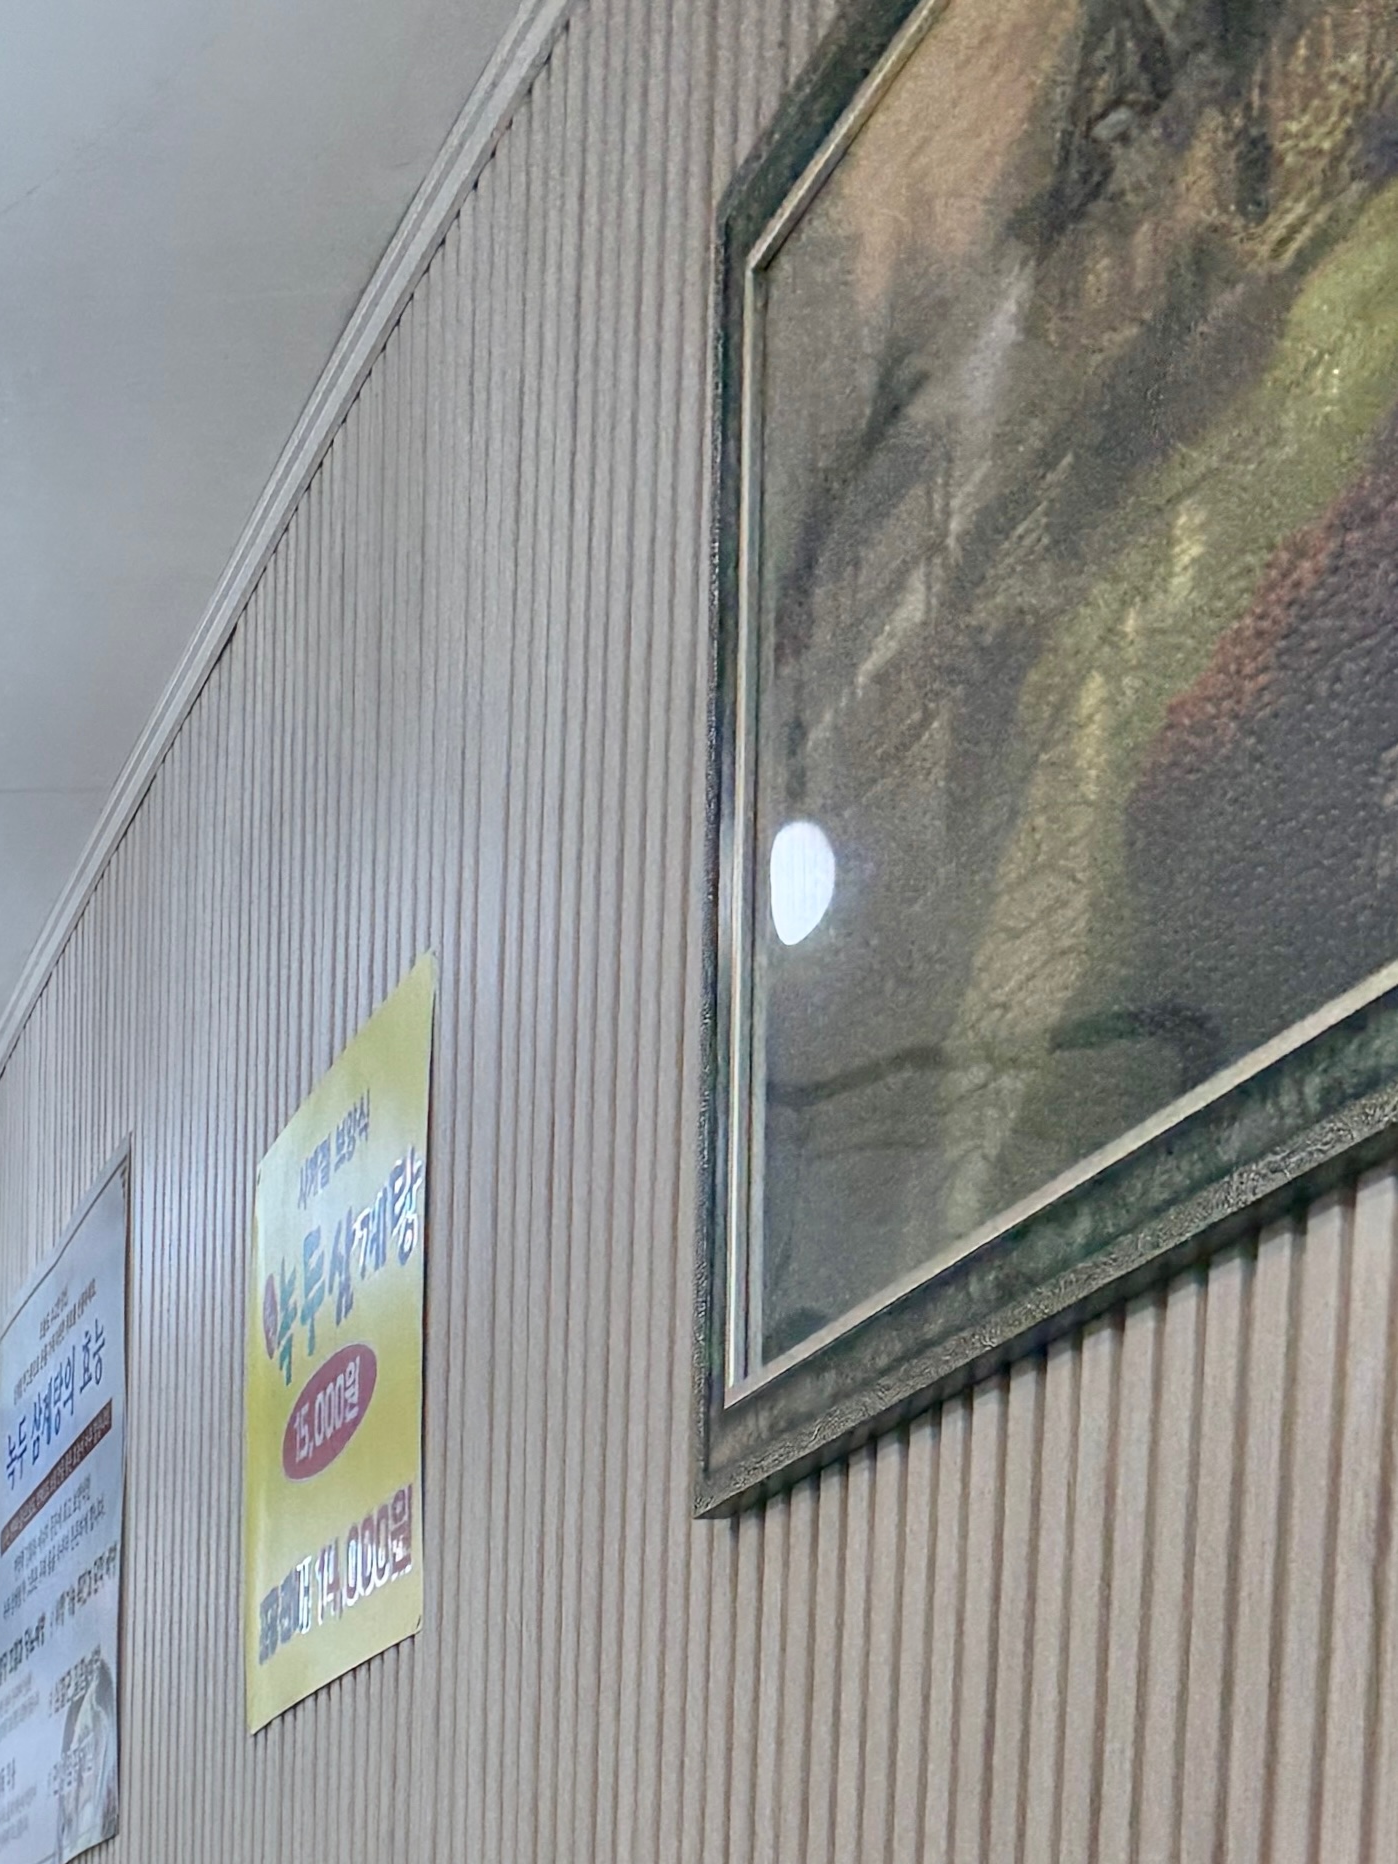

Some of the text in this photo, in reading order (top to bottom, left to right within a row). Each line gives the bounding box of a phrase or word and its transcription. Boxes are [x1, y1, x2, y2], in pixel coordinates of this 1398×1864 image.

[334, 1087, 371, 1173] 보양식
[278, 1144, 425, 1386] 녹두삼계탕
[6, 1414, 27, 1490] 녹두
[79, 1318, 106, 1394] 효능
[294, 1355, 360, 1464] 15,000원
